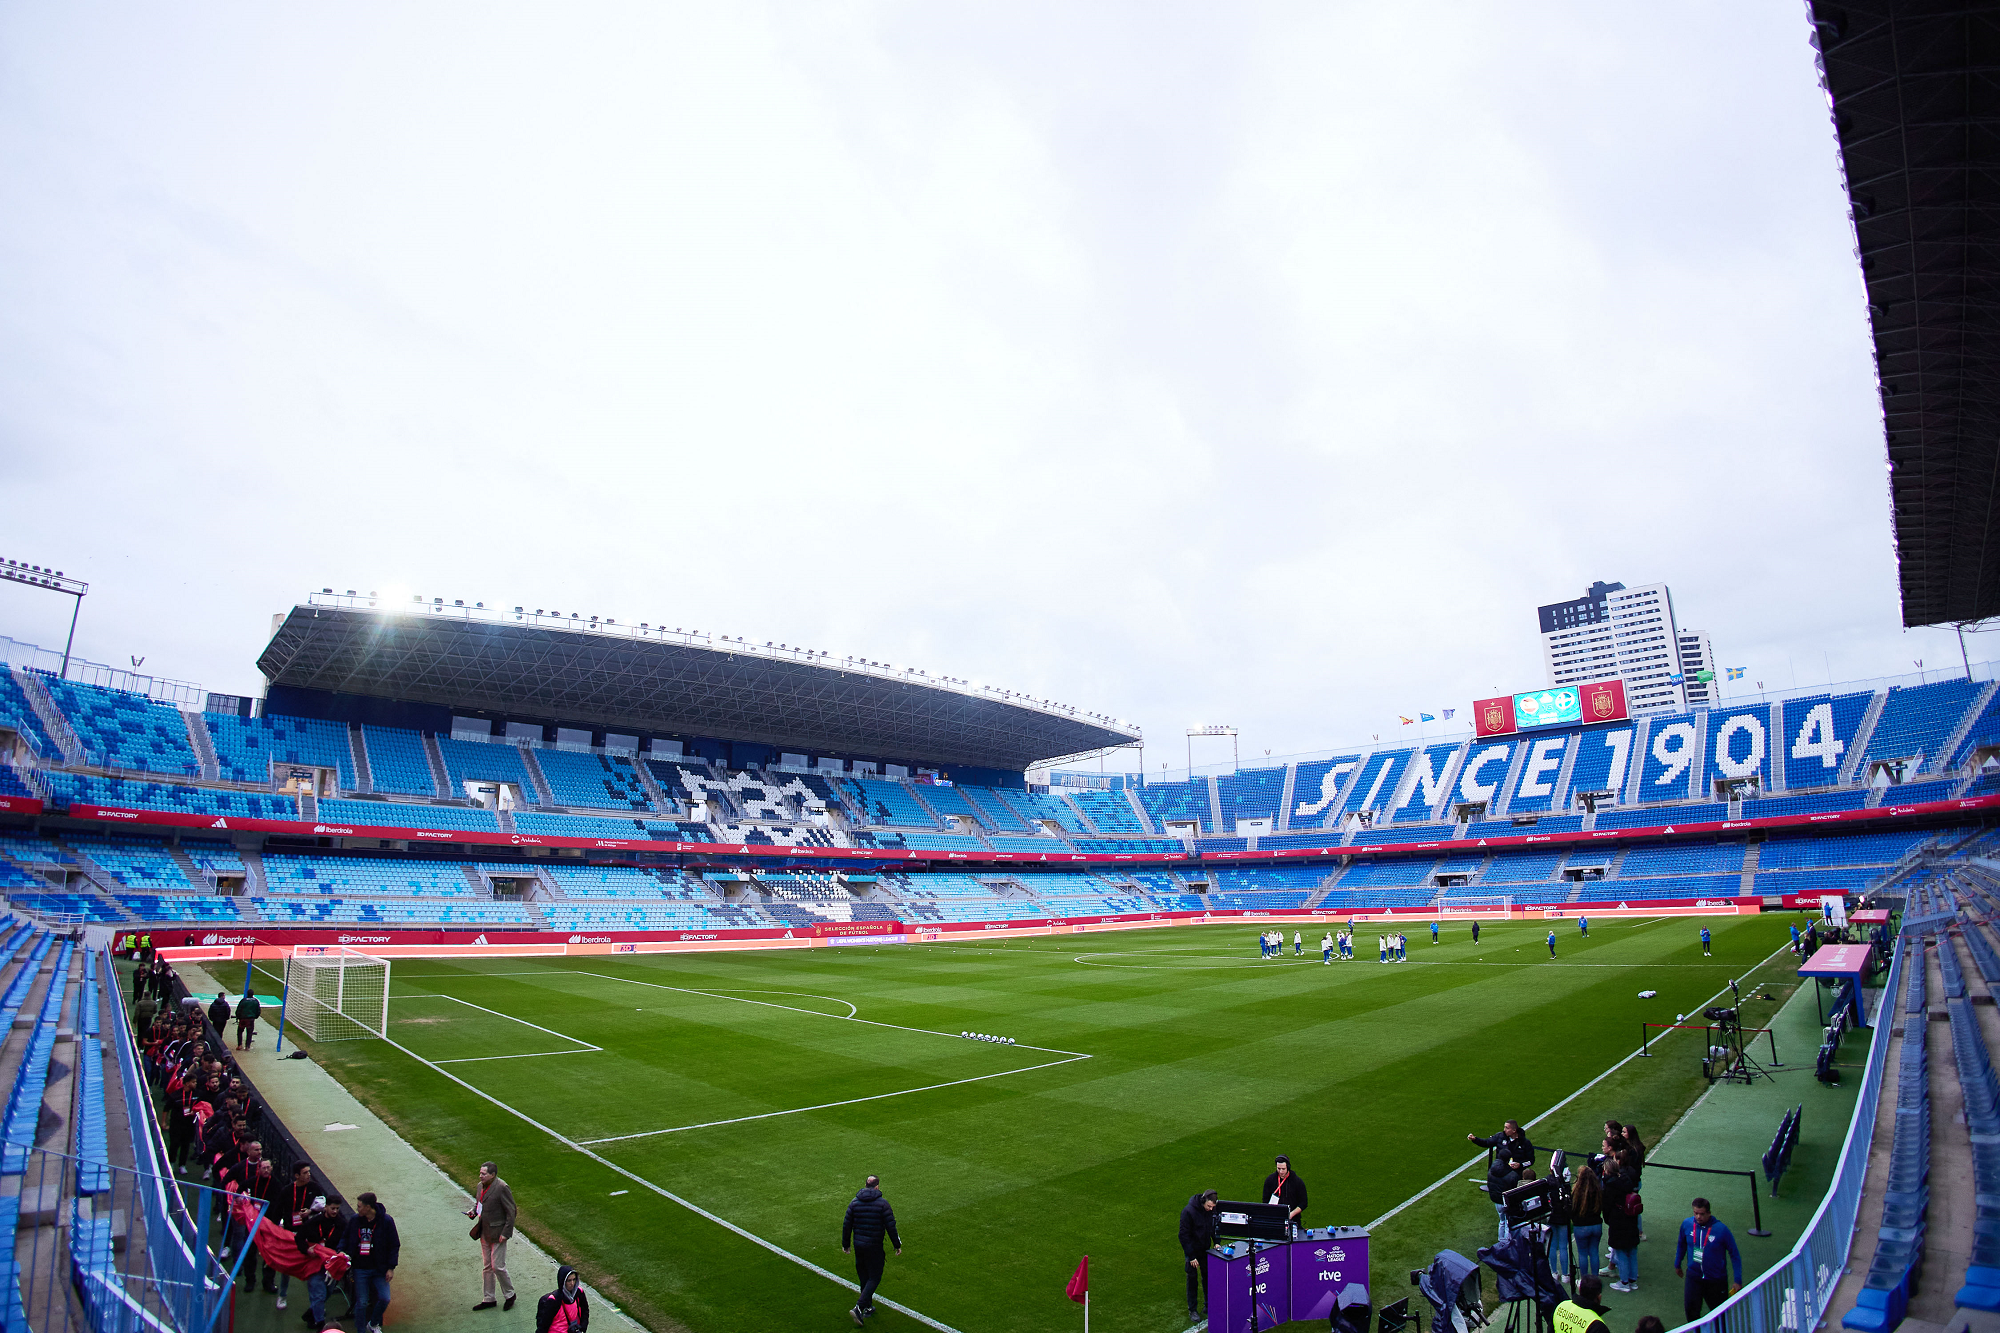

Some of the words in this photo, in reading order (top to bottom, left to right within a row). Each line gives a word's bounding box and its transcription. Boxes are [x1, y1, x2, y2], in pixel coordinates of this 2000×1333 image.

[1295, 738, 1565, 816] SINCE
[1604, 702, 1845, 790] 1904
[107, 811, 139, 819] FACTORY
[325, 826, 353, 834] Iberdrola
[581, 935, 612, 944] Iberdrola
[1318, 1270, 1341, 1281] rtve
[1248, 1282, 1267, 1296] rve
[1557, 1307, 1587, 1329] SEGURIDAD
